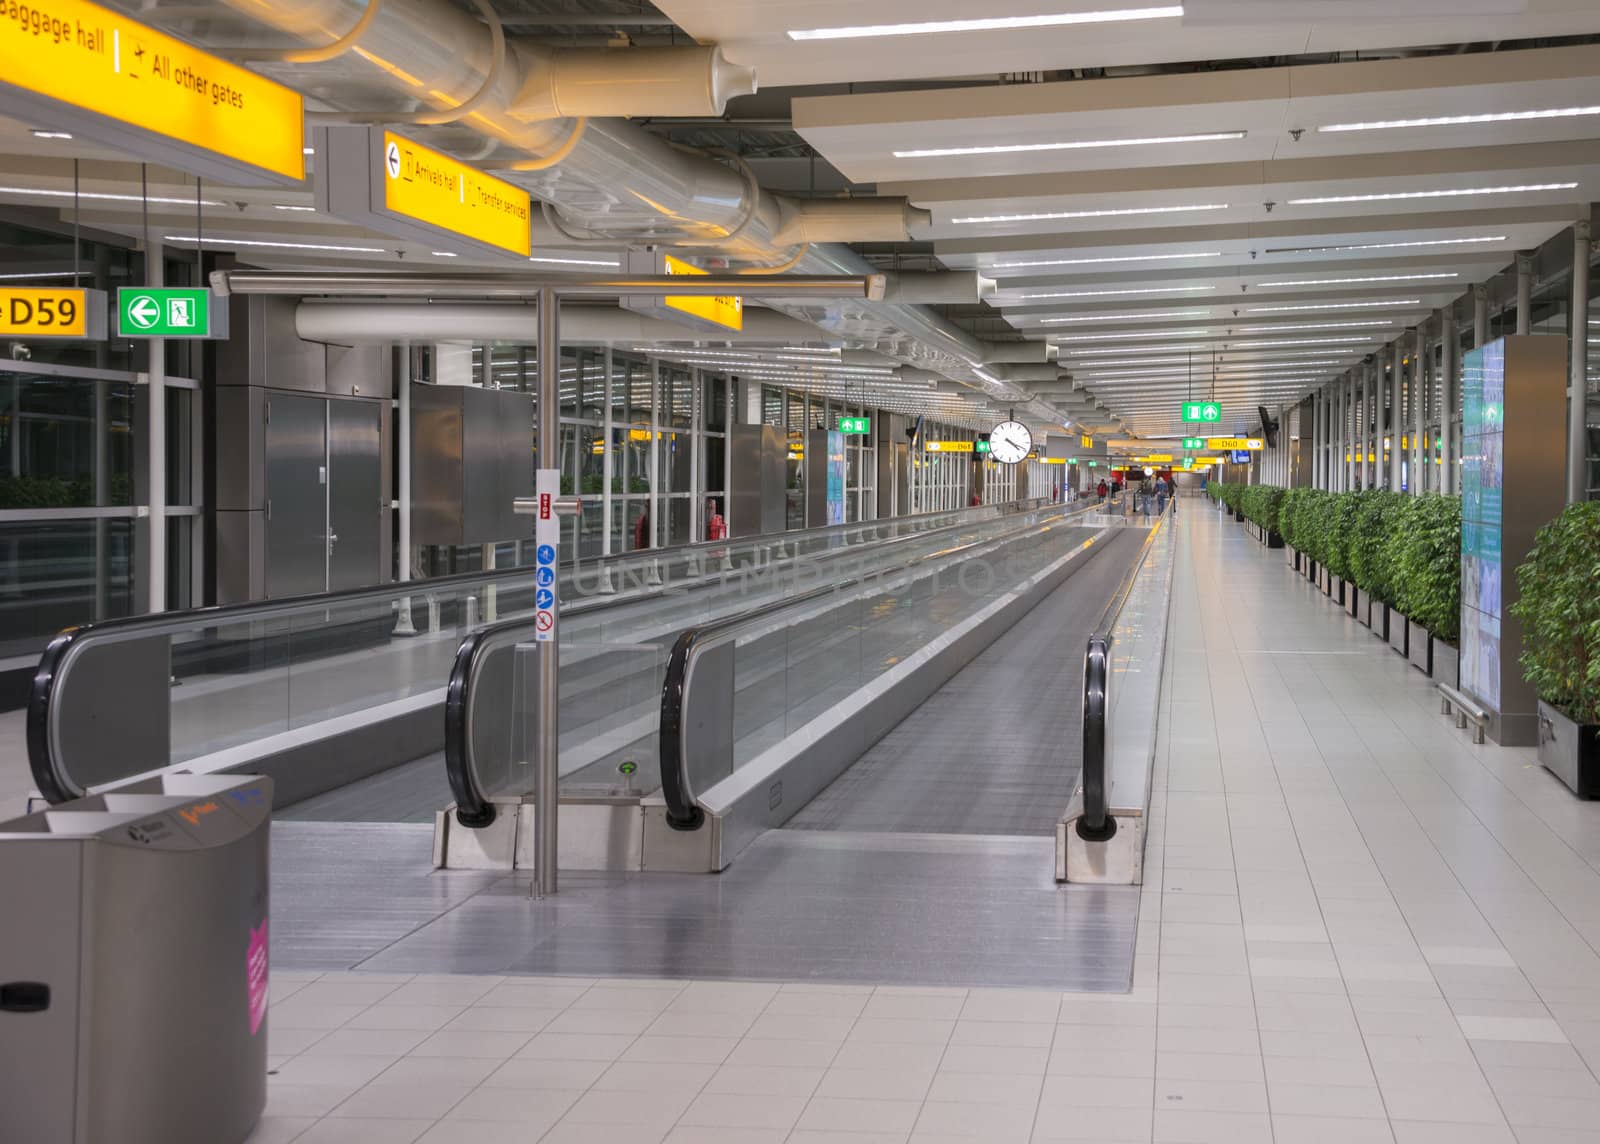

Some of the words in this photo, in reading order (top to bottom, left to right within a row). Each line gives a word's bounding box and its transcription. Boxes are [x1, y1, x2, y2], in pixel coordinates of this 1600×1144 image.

[76, 19, 105, 56] hall
[152, 54, 170, 81] All
[174, 65, 208, 96] other
[211, 82, 243, 109] gates
[415, 160, 442, 187] Arrivals
[445, 172, 457, 192] hall
[477, 185, 503, 210] Transfer
[504, 200, 527, 220] services
[10, 297, 76, 326] D59
